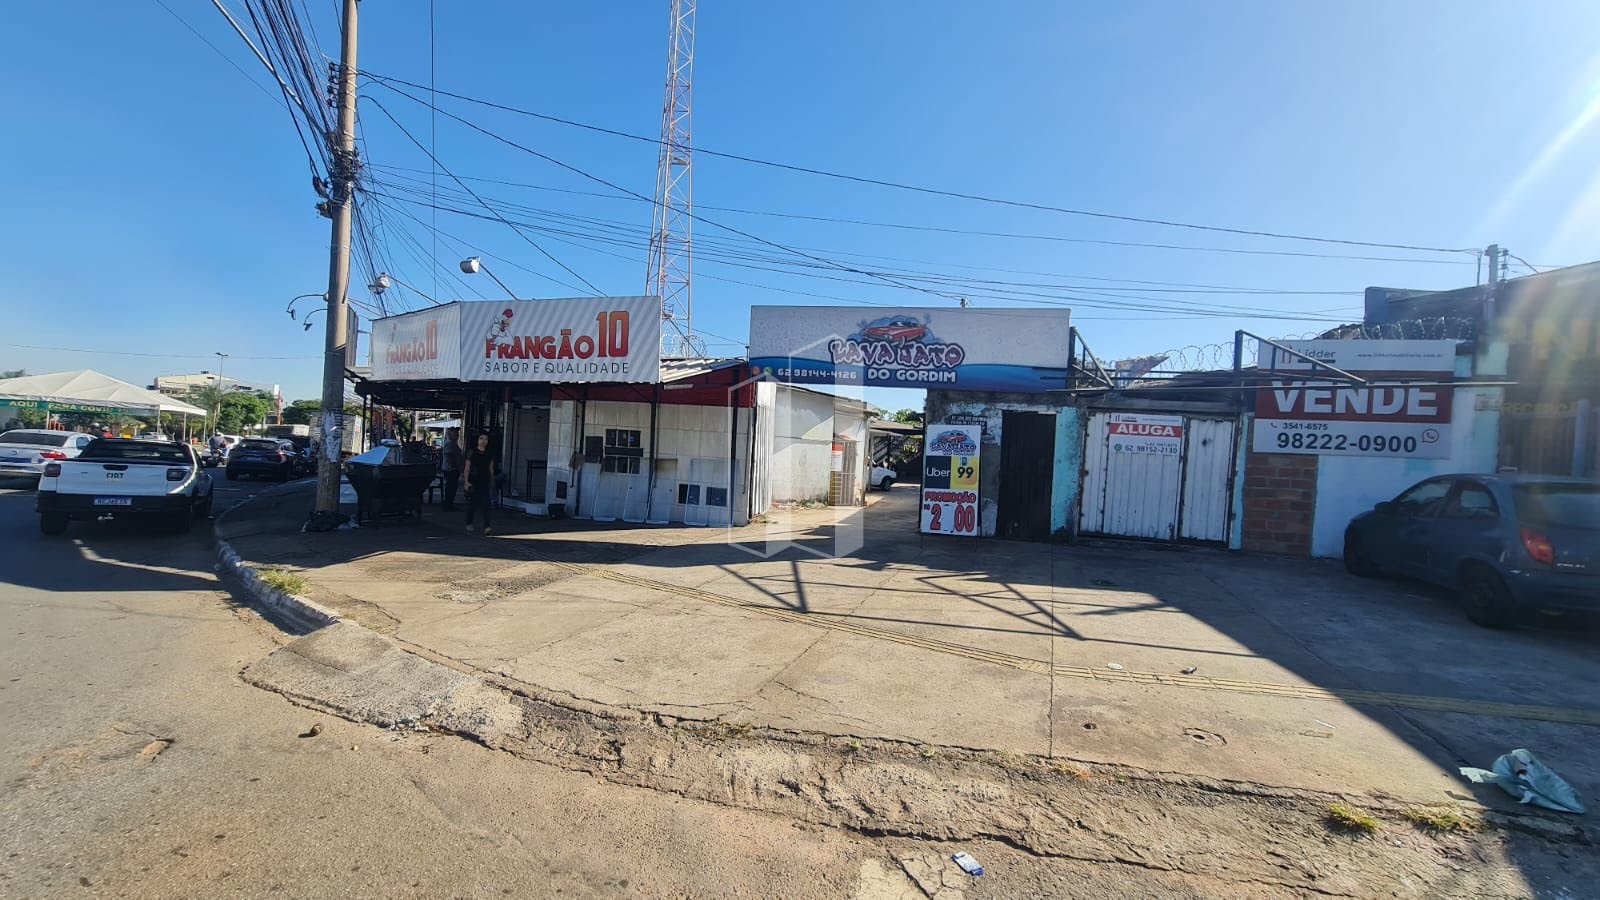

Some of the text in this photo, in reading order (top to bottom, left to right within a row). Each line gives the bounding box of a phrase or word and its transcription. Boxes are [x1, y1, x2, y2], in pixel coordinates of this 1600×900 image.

[426, 319, 438, 360] 10
[485, 310, 630, 360] FRANGÃO 10
[828, 338, 965, 368] LAVA JATO
[485, 361, 630, 375] SABOR E QUALIDADE
[793, 368, 857, 380] 98144-4126
[867, 368, 956, 383] DO GORDIM
[9, 400, 38, 408] AQUI
[1272, 381, 1437, 416] VENDE
[1117, 425, 1175, 436] ALUGA
[1282, 422, 1328, 431] 3541-6575
[1276, 431, 1417, 454] 98222-0900
[926, 466, 951, 477] Uber
[957, 466, 974, 479] 99
